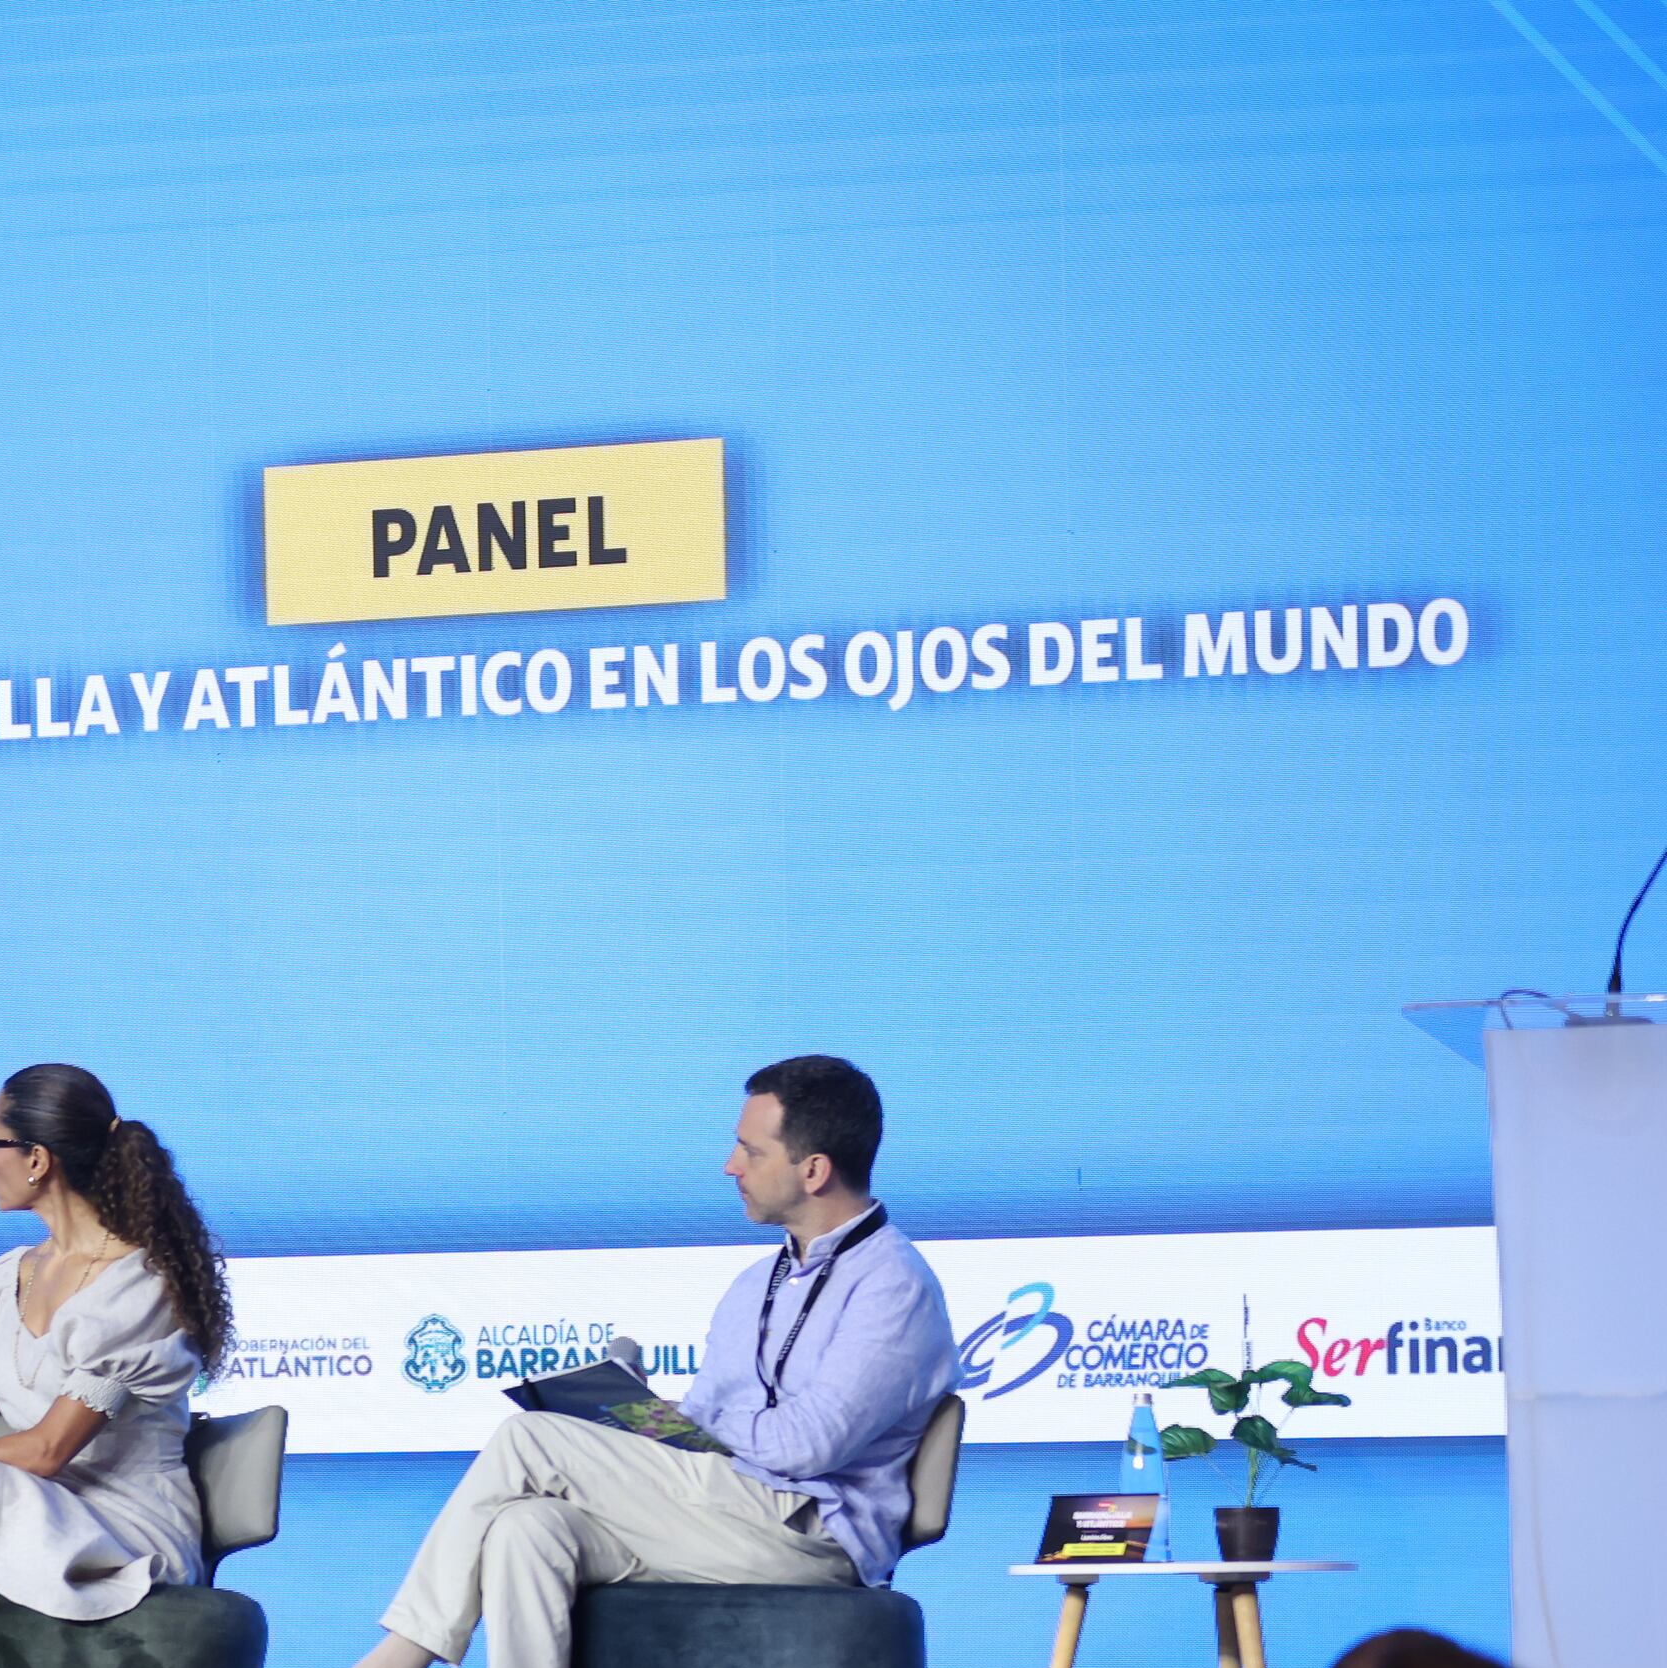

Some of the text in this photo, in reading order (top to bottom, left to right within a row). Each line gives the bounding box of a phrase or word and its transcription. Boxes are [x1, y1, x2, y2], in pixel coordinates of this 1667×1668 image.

[372, 495, 627, 578] PANEL
[129, 671, 174, 734] Y
[181, 641, 571, 732] ATLÁNTICO
[589, 643, 679, 710] EN
[699, 633, 828, 705] LOS
[844, 622, 1012, 711] OJOS
[1027, 616, 1164, 686] DEL
[1182, 597, 1469, 677] MUNDO
[477, 1318, 614, 1346] ALCALDÍA DE
[1087, 1314, 1210, 1342] CÁMARA DE
[1424, 1317, 1467, 1332] Banco
[341, 1337, 370, 1350] DEL
[1065, 1343, 1208, 1371] COMERCIO
[1297, 1317, 1504, 1377] Serfina
[227, 1351, 373, 1378] ATLÁNTICO
[476, 1345, 700, 1379] BARRANUILL
[1057, 1373, 1076, 1388] DE
